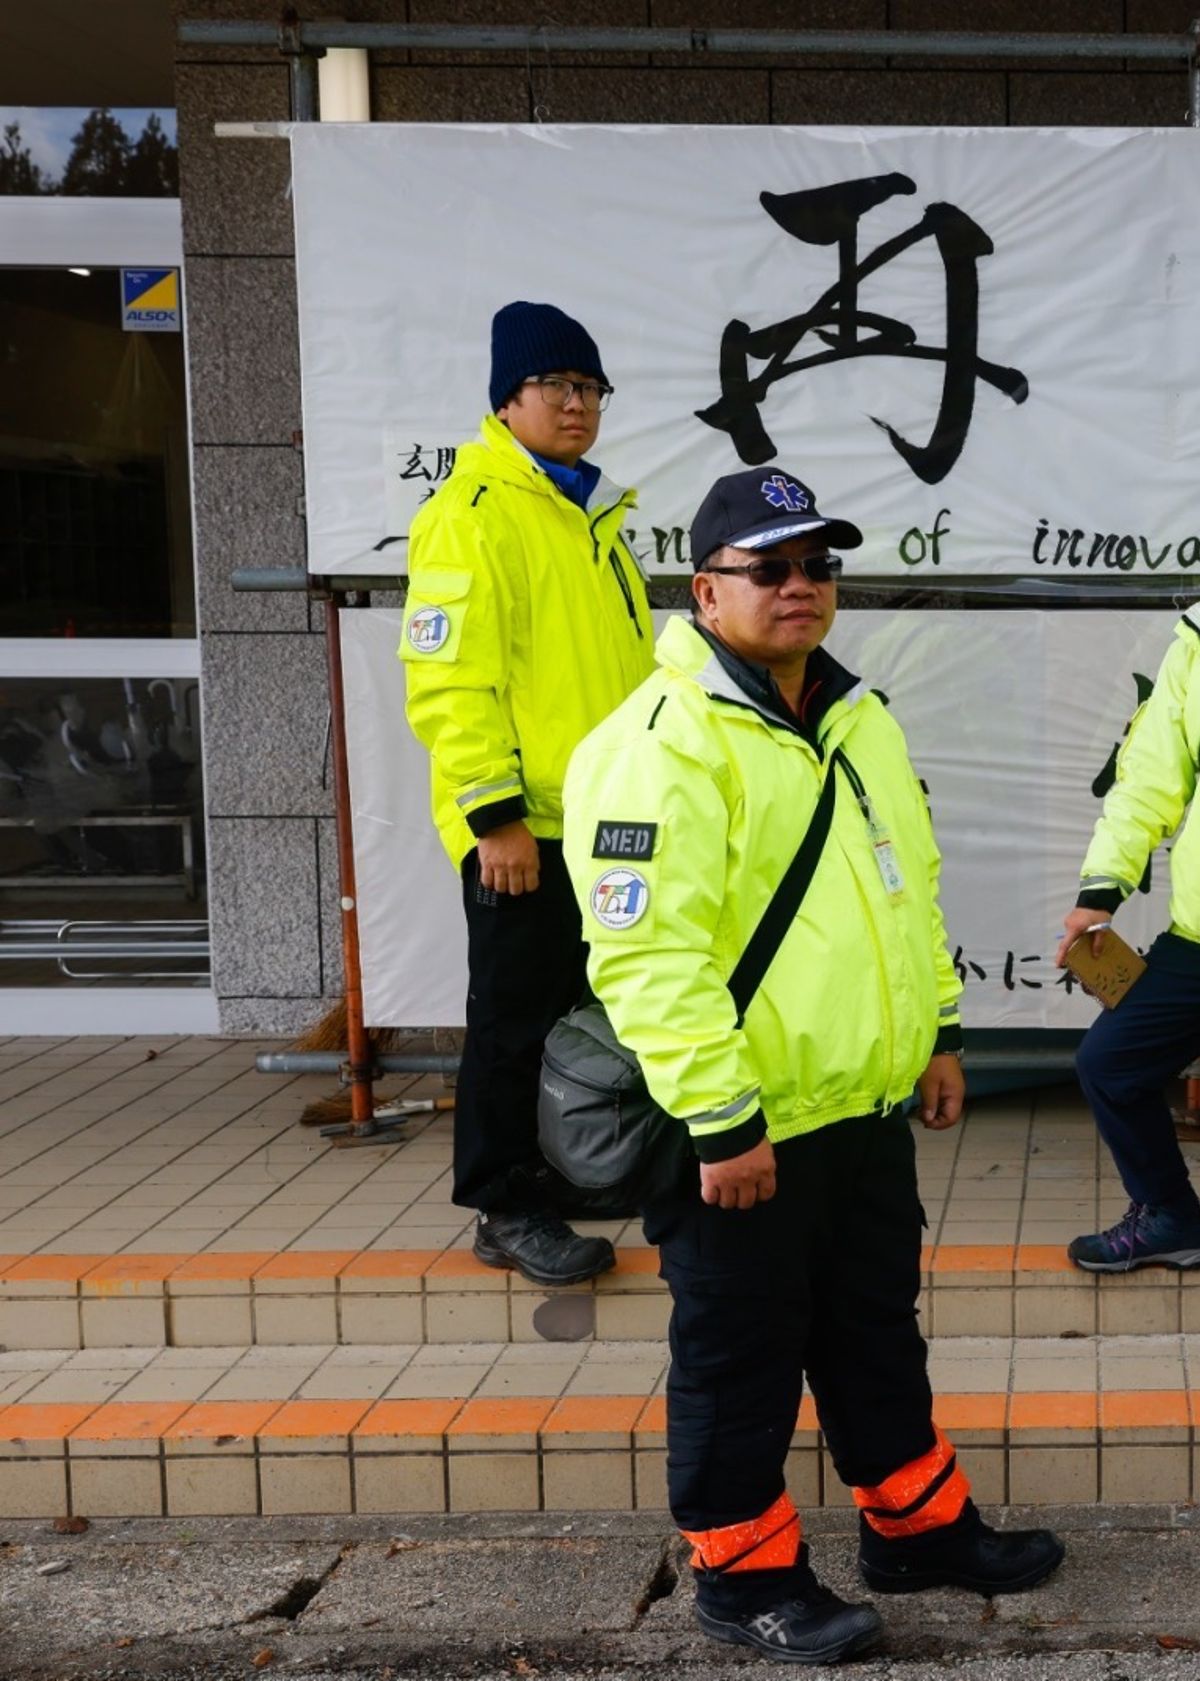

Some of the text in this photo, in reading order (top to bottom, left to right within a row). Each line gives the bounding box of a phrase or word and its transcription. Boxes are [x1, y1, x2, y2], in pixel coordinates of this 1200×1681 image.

[126, 310, 177, 322] ALSOK
[899, 508, 951, 566] of
[599, 827, 650, 854] MED
